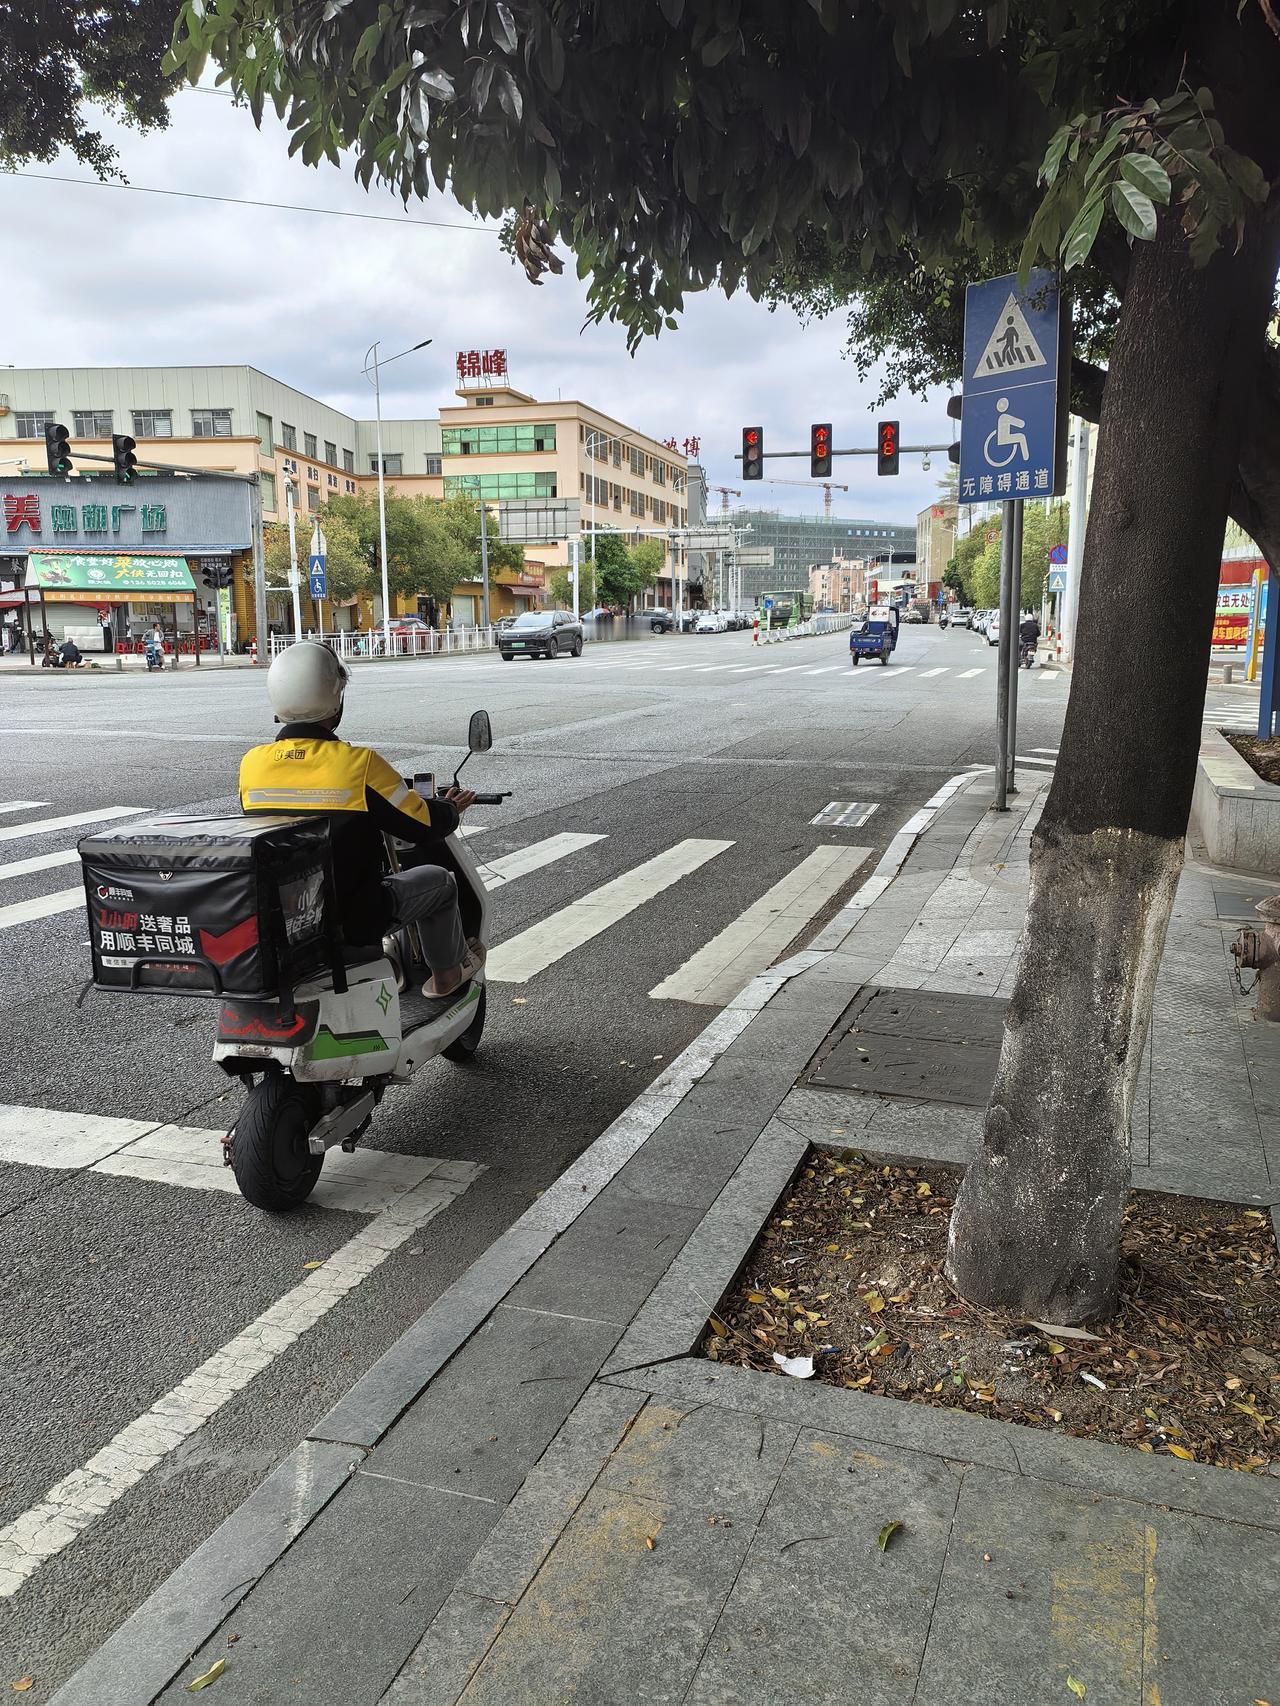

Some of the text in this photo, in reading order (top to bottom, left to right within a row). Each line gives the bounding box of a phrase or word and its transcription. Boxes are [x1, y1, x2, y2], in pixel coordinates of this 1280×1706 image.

[456, 349, 507, 378] 锦峰
[962, 468, 1050, 498] 无障碍通道
[284, 749, 306, 760] 美团
[100, 930, 196, 955] 用顺丰同城
